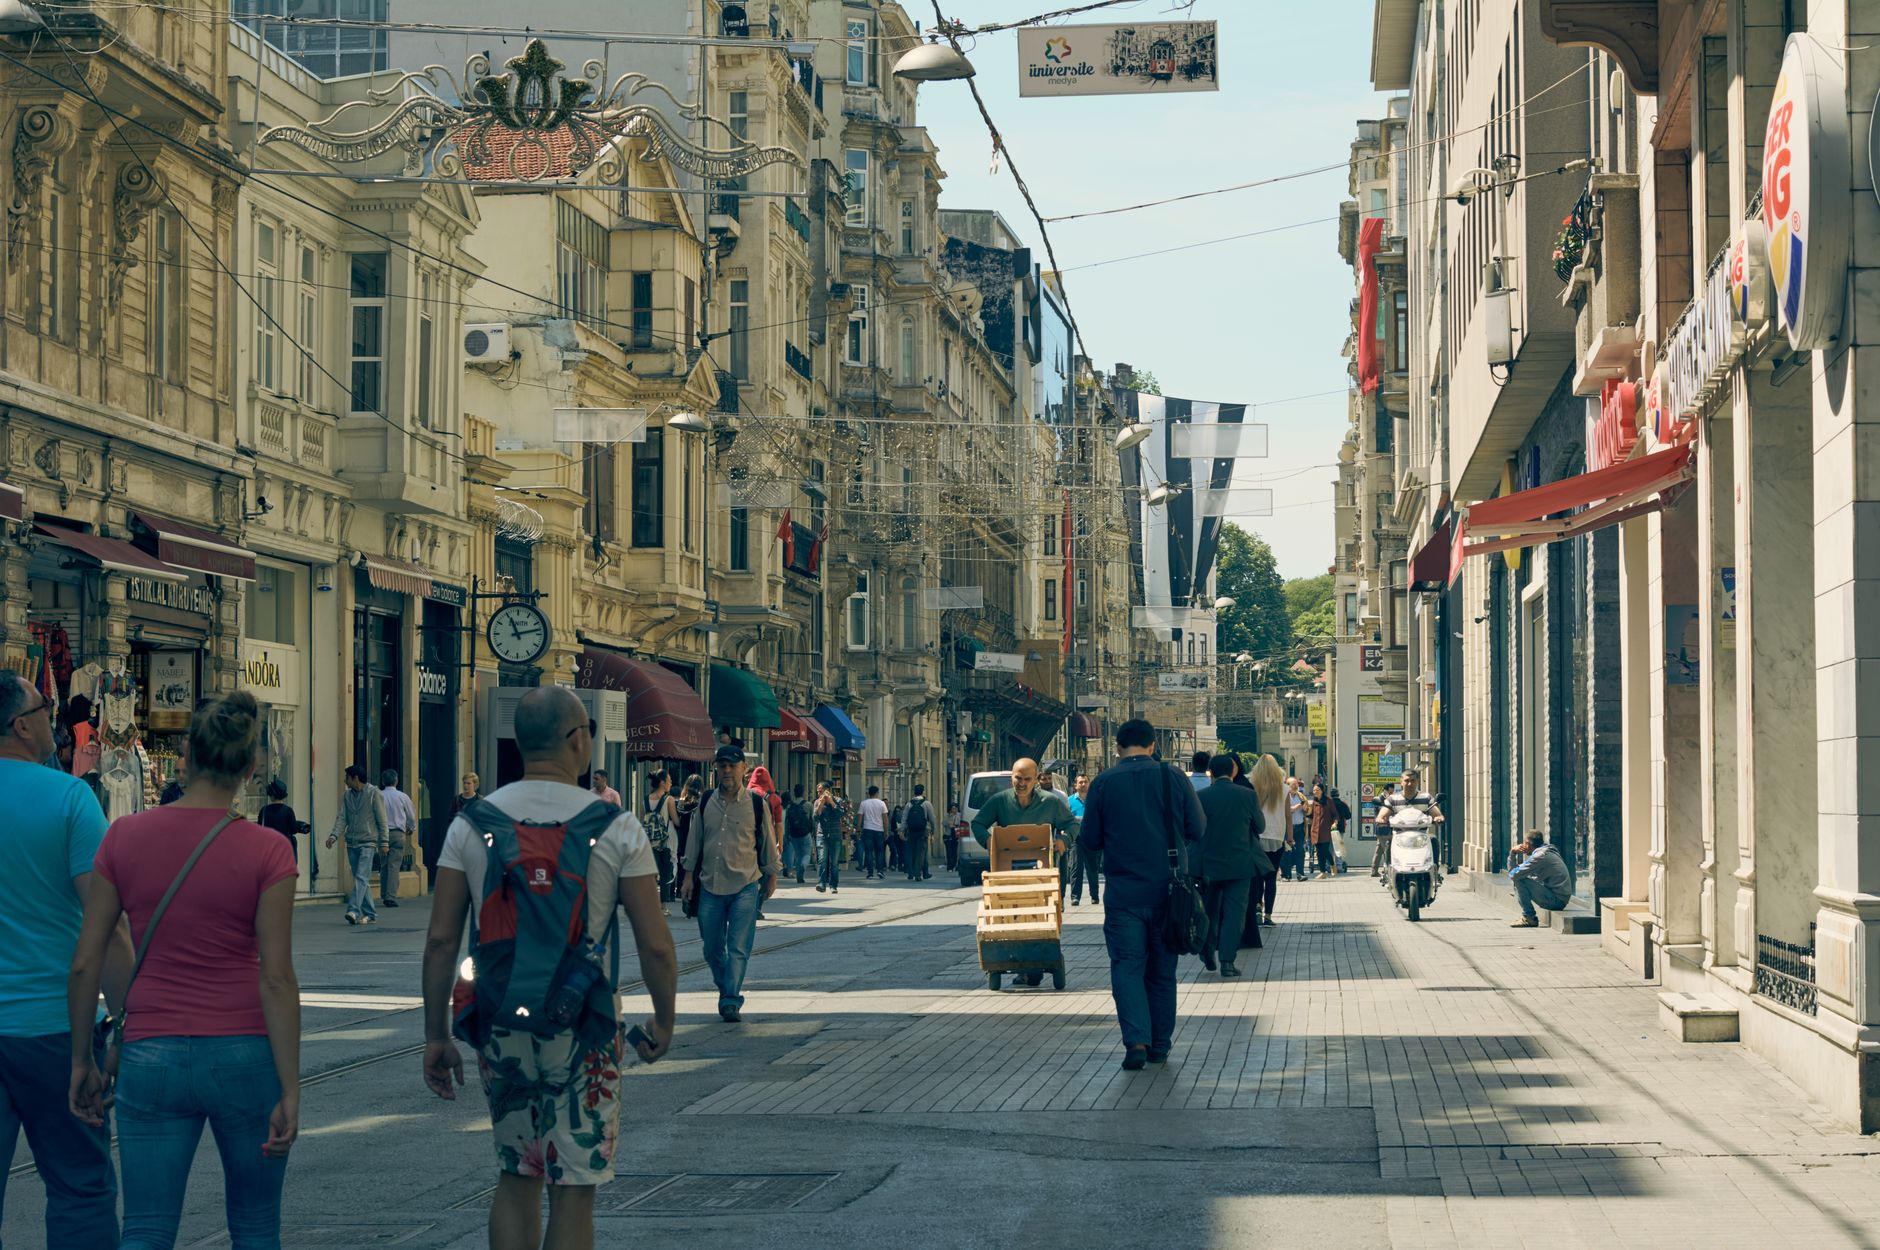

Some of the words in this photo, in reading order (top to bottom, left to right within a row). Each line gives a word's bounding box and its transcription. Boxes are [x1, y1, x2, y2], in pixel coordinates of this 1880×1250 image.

[1029, 61, 1095, 78] üniversite
[1048, 77, 1077, 86] medya
[440, 584, 459, 603] balance
[770, 729, 799, 737] SuperStep
